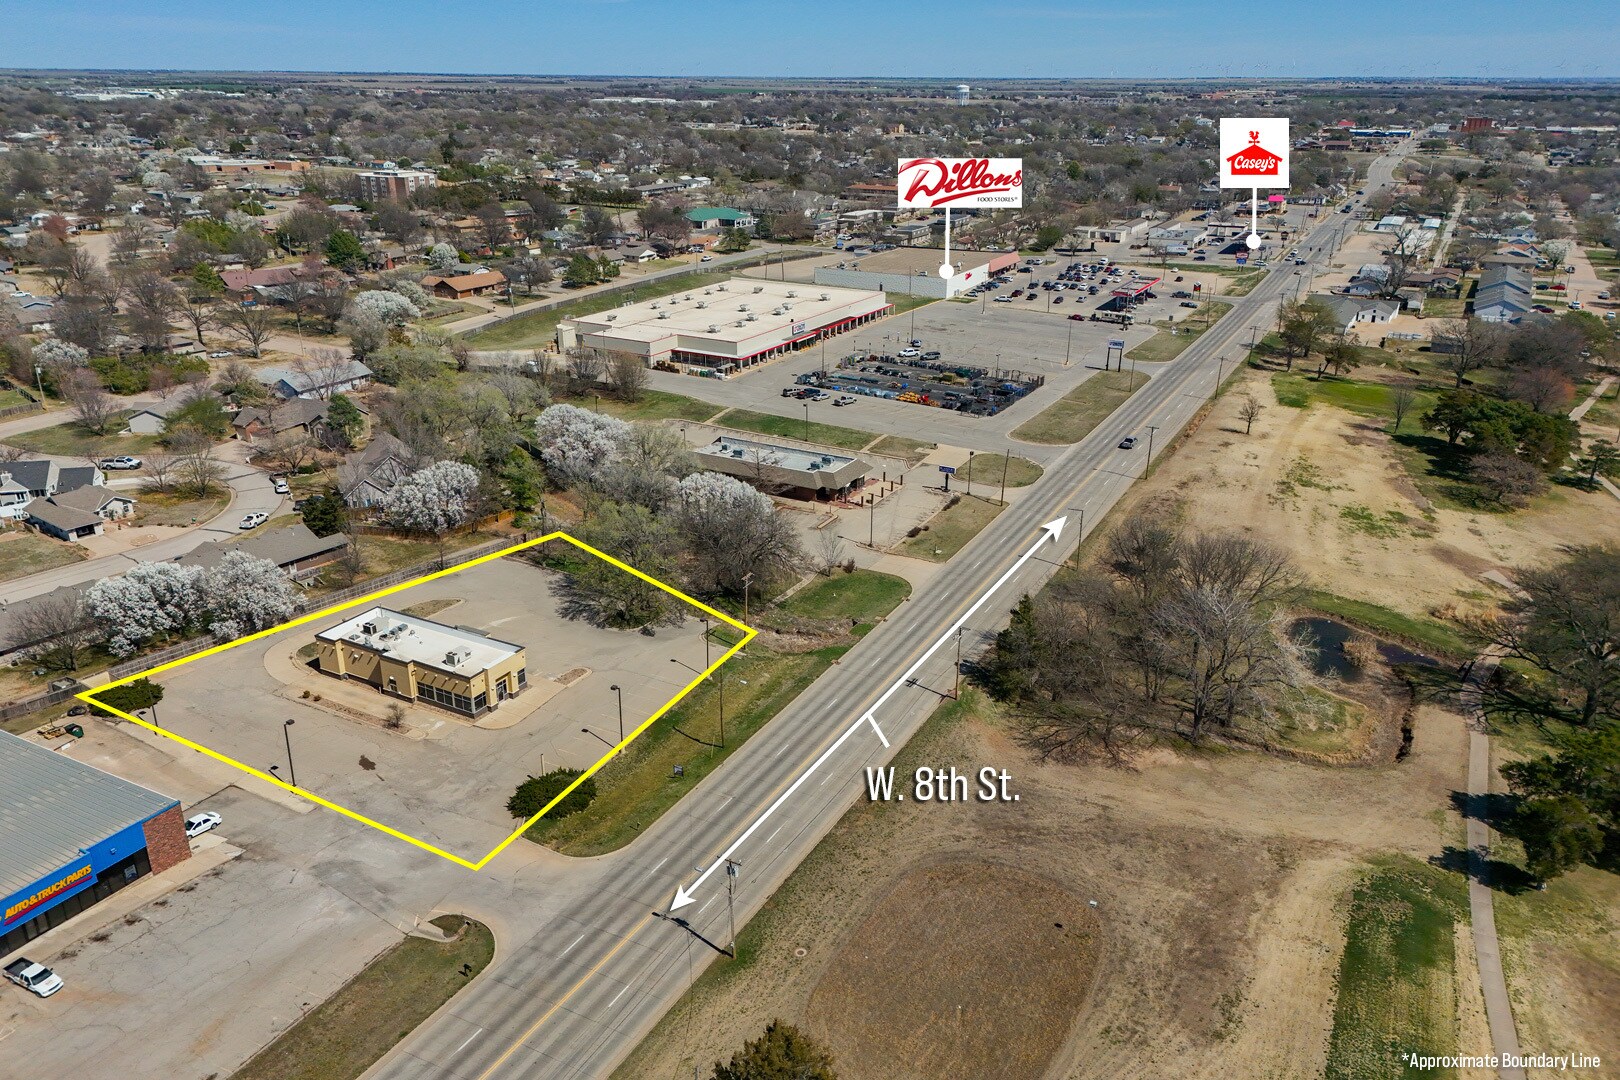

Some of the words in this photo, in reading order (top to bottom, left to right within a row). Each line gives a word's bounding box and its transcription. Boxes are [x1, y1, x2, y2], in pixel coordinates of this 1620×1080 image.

[4, 899, 29, 920] AUTO
[29, 894, 39, 906] &
[36, 876, 68, 901] TRUCK
[66, 864, 92, 885] PARTS
